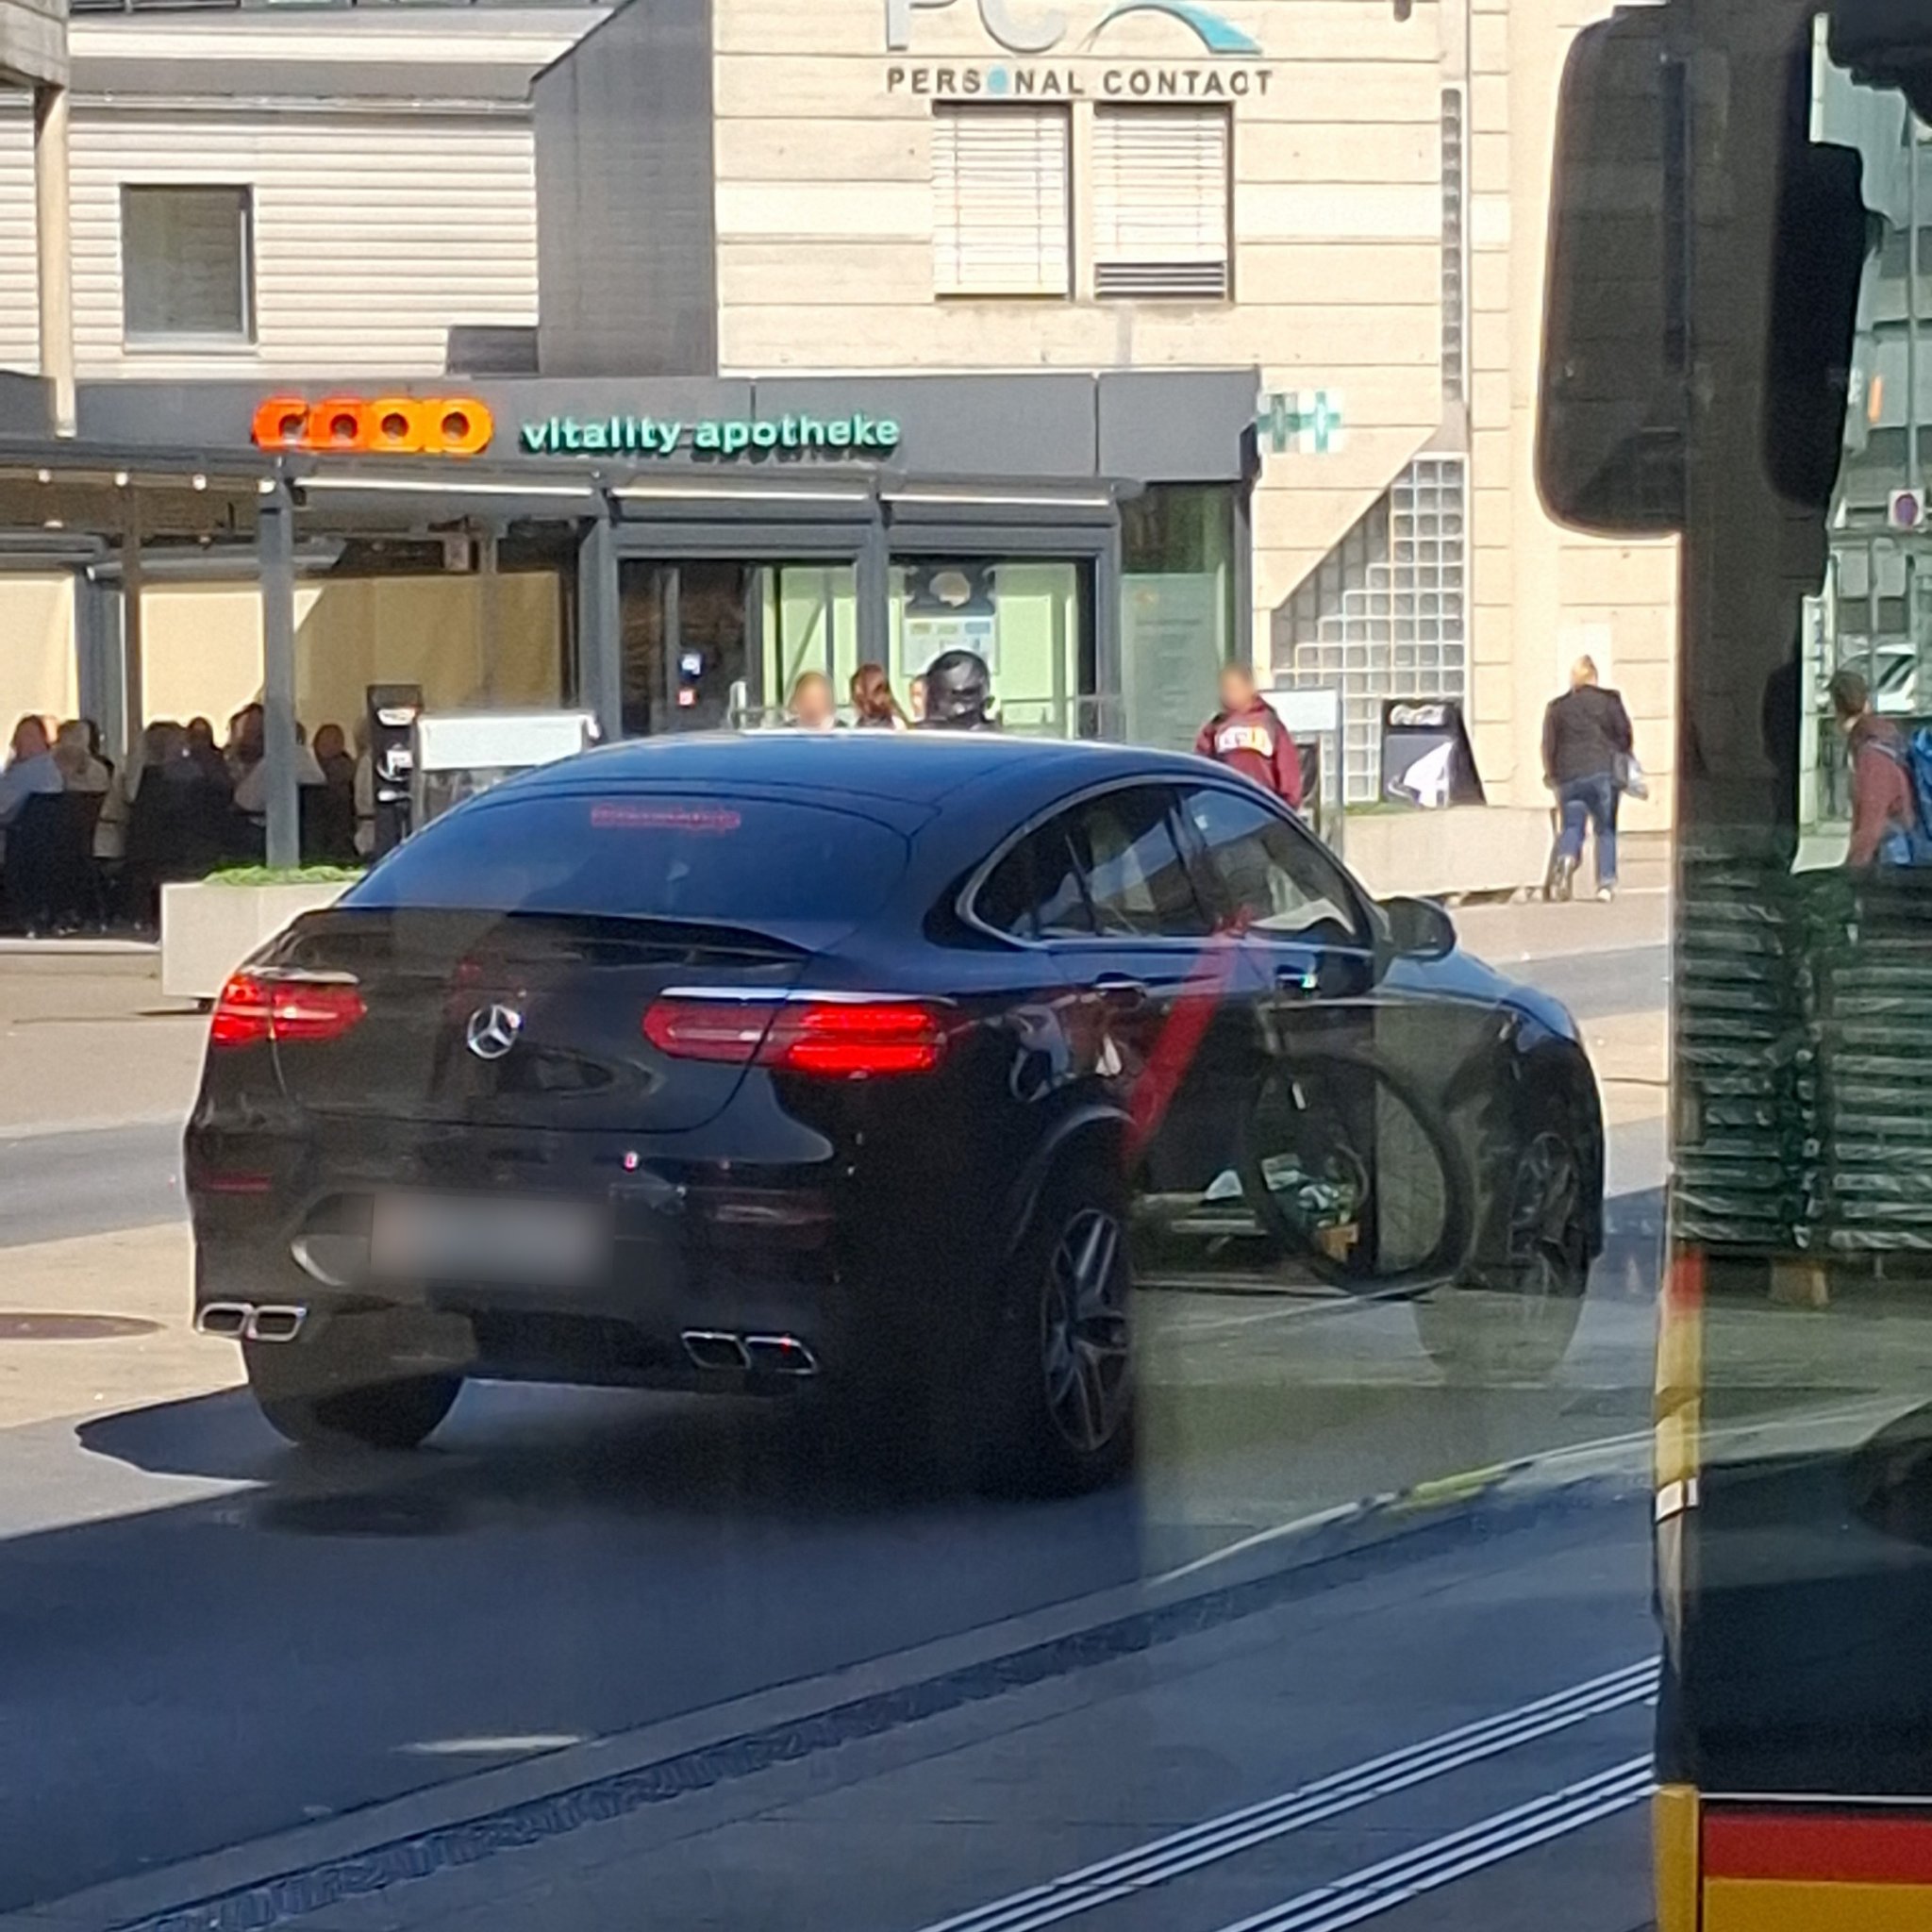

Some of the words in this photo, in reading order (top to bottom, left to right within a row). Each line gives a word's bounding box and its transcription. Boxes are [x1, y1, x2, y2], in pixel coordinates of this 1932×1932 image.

[887, 67, 1085, 94] PERSONAL
[1102, 70, 1274, 95] CONTACT
[522, 416, 680, 453] vitality
[693, 413, 901, 453] apotheke
